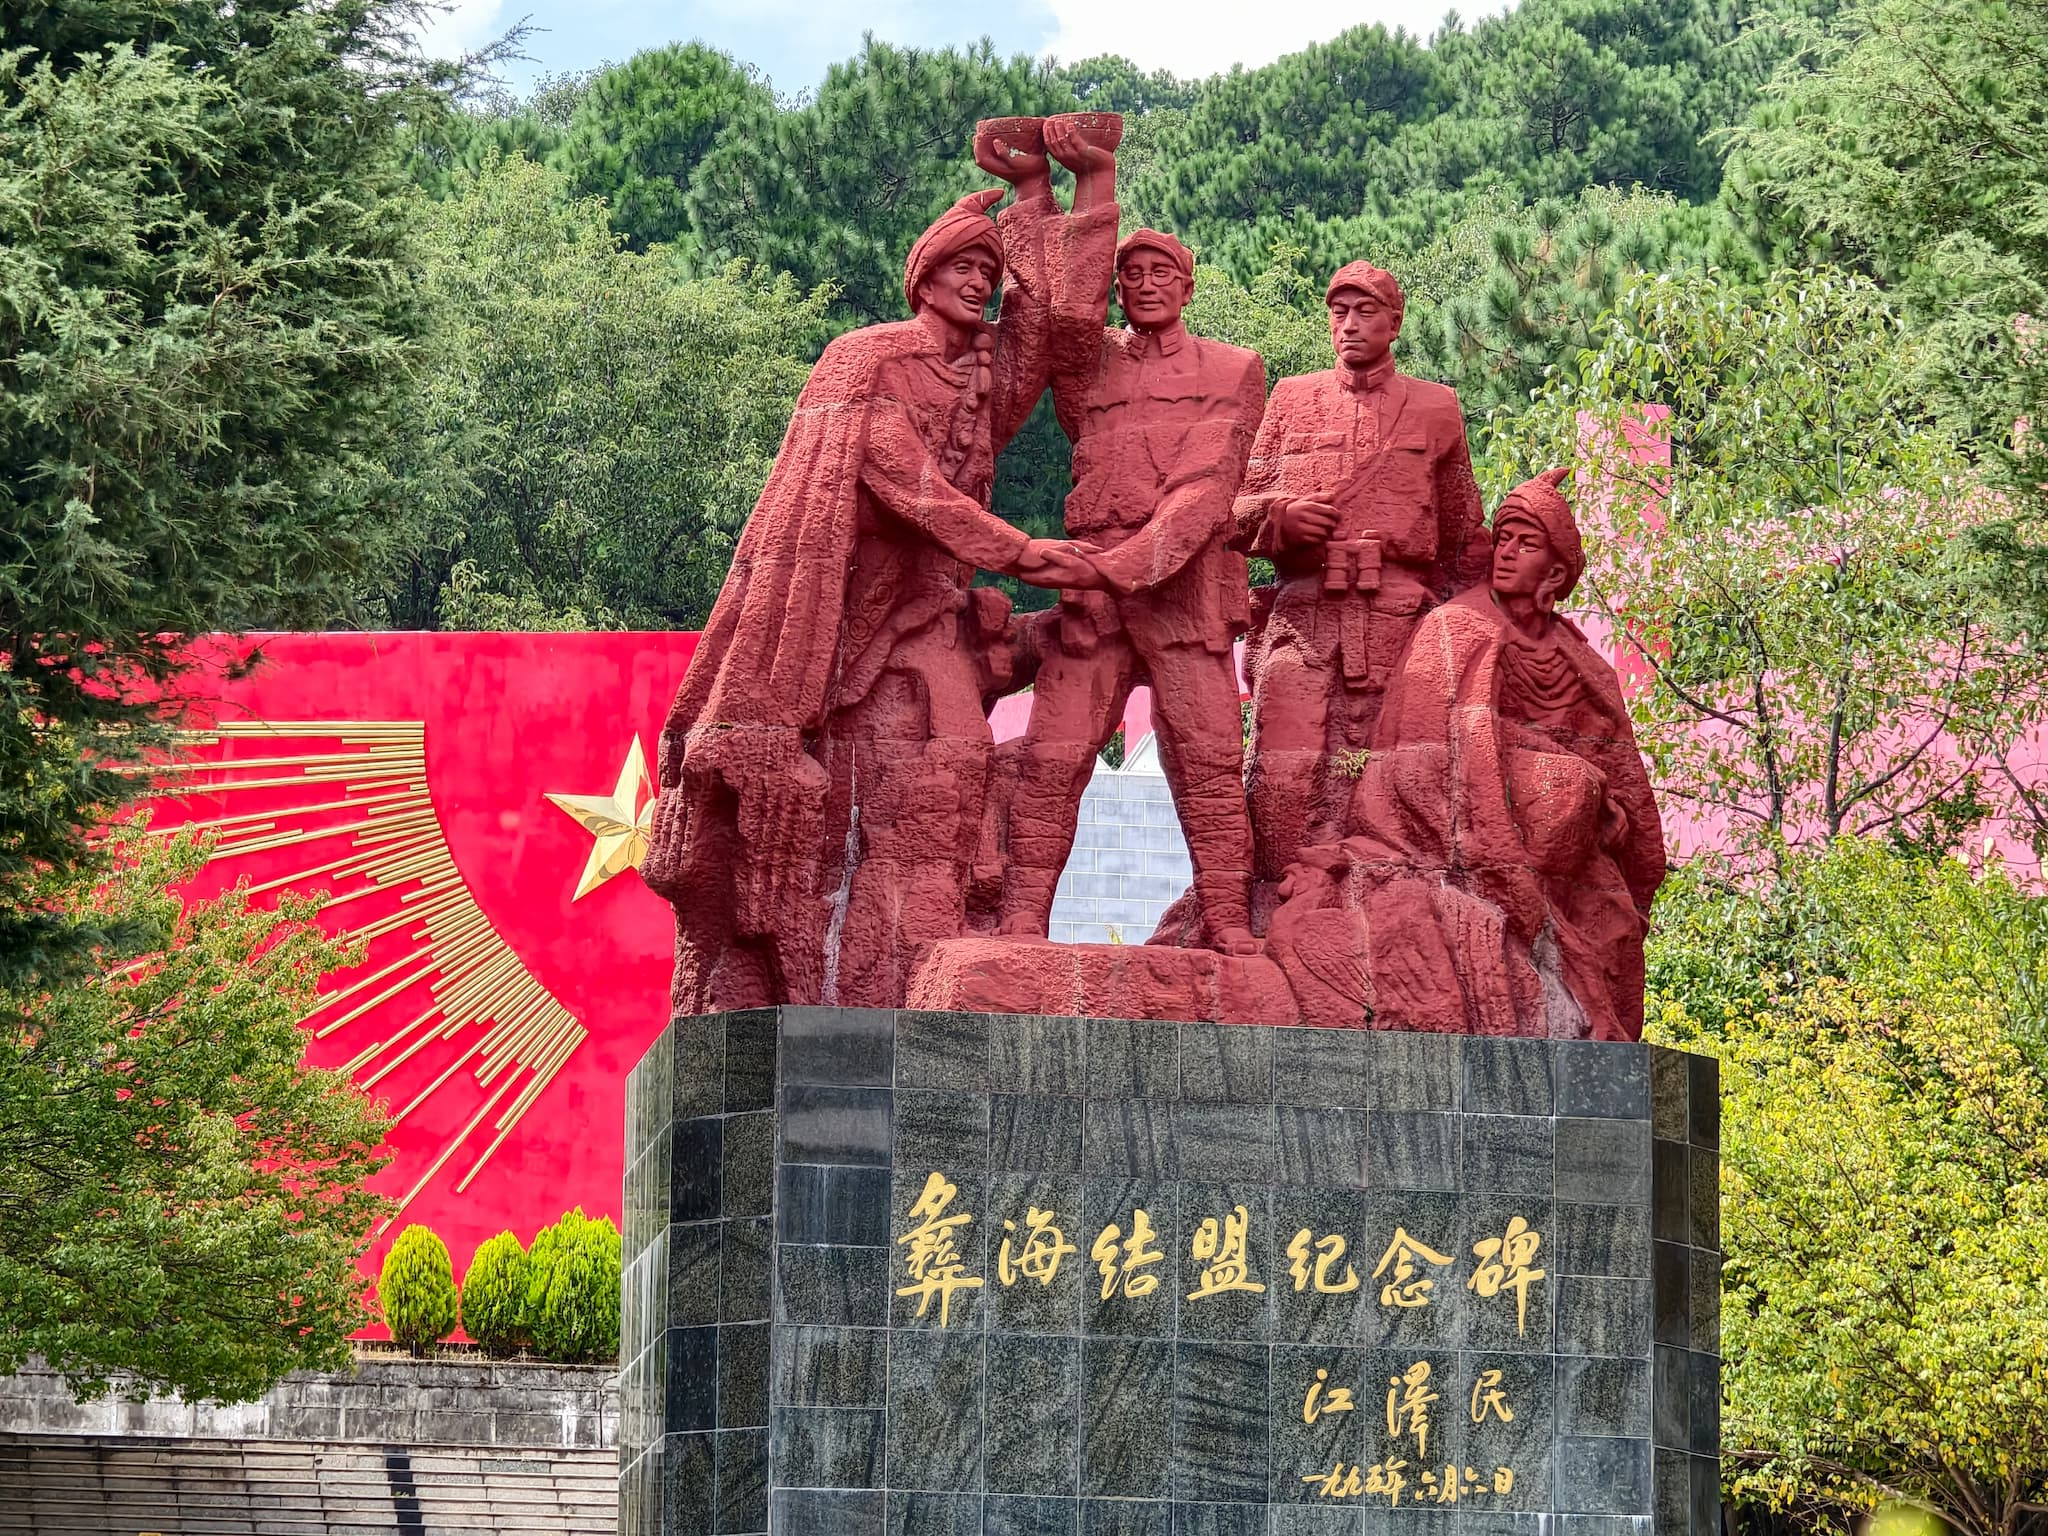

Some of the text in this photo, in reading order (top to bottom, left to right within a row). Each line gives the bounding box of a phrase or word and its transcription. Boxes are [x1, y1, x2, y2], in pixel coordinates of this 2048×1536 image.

[895, 1171, 1546, 1337] 彝海结盟纪念碑
